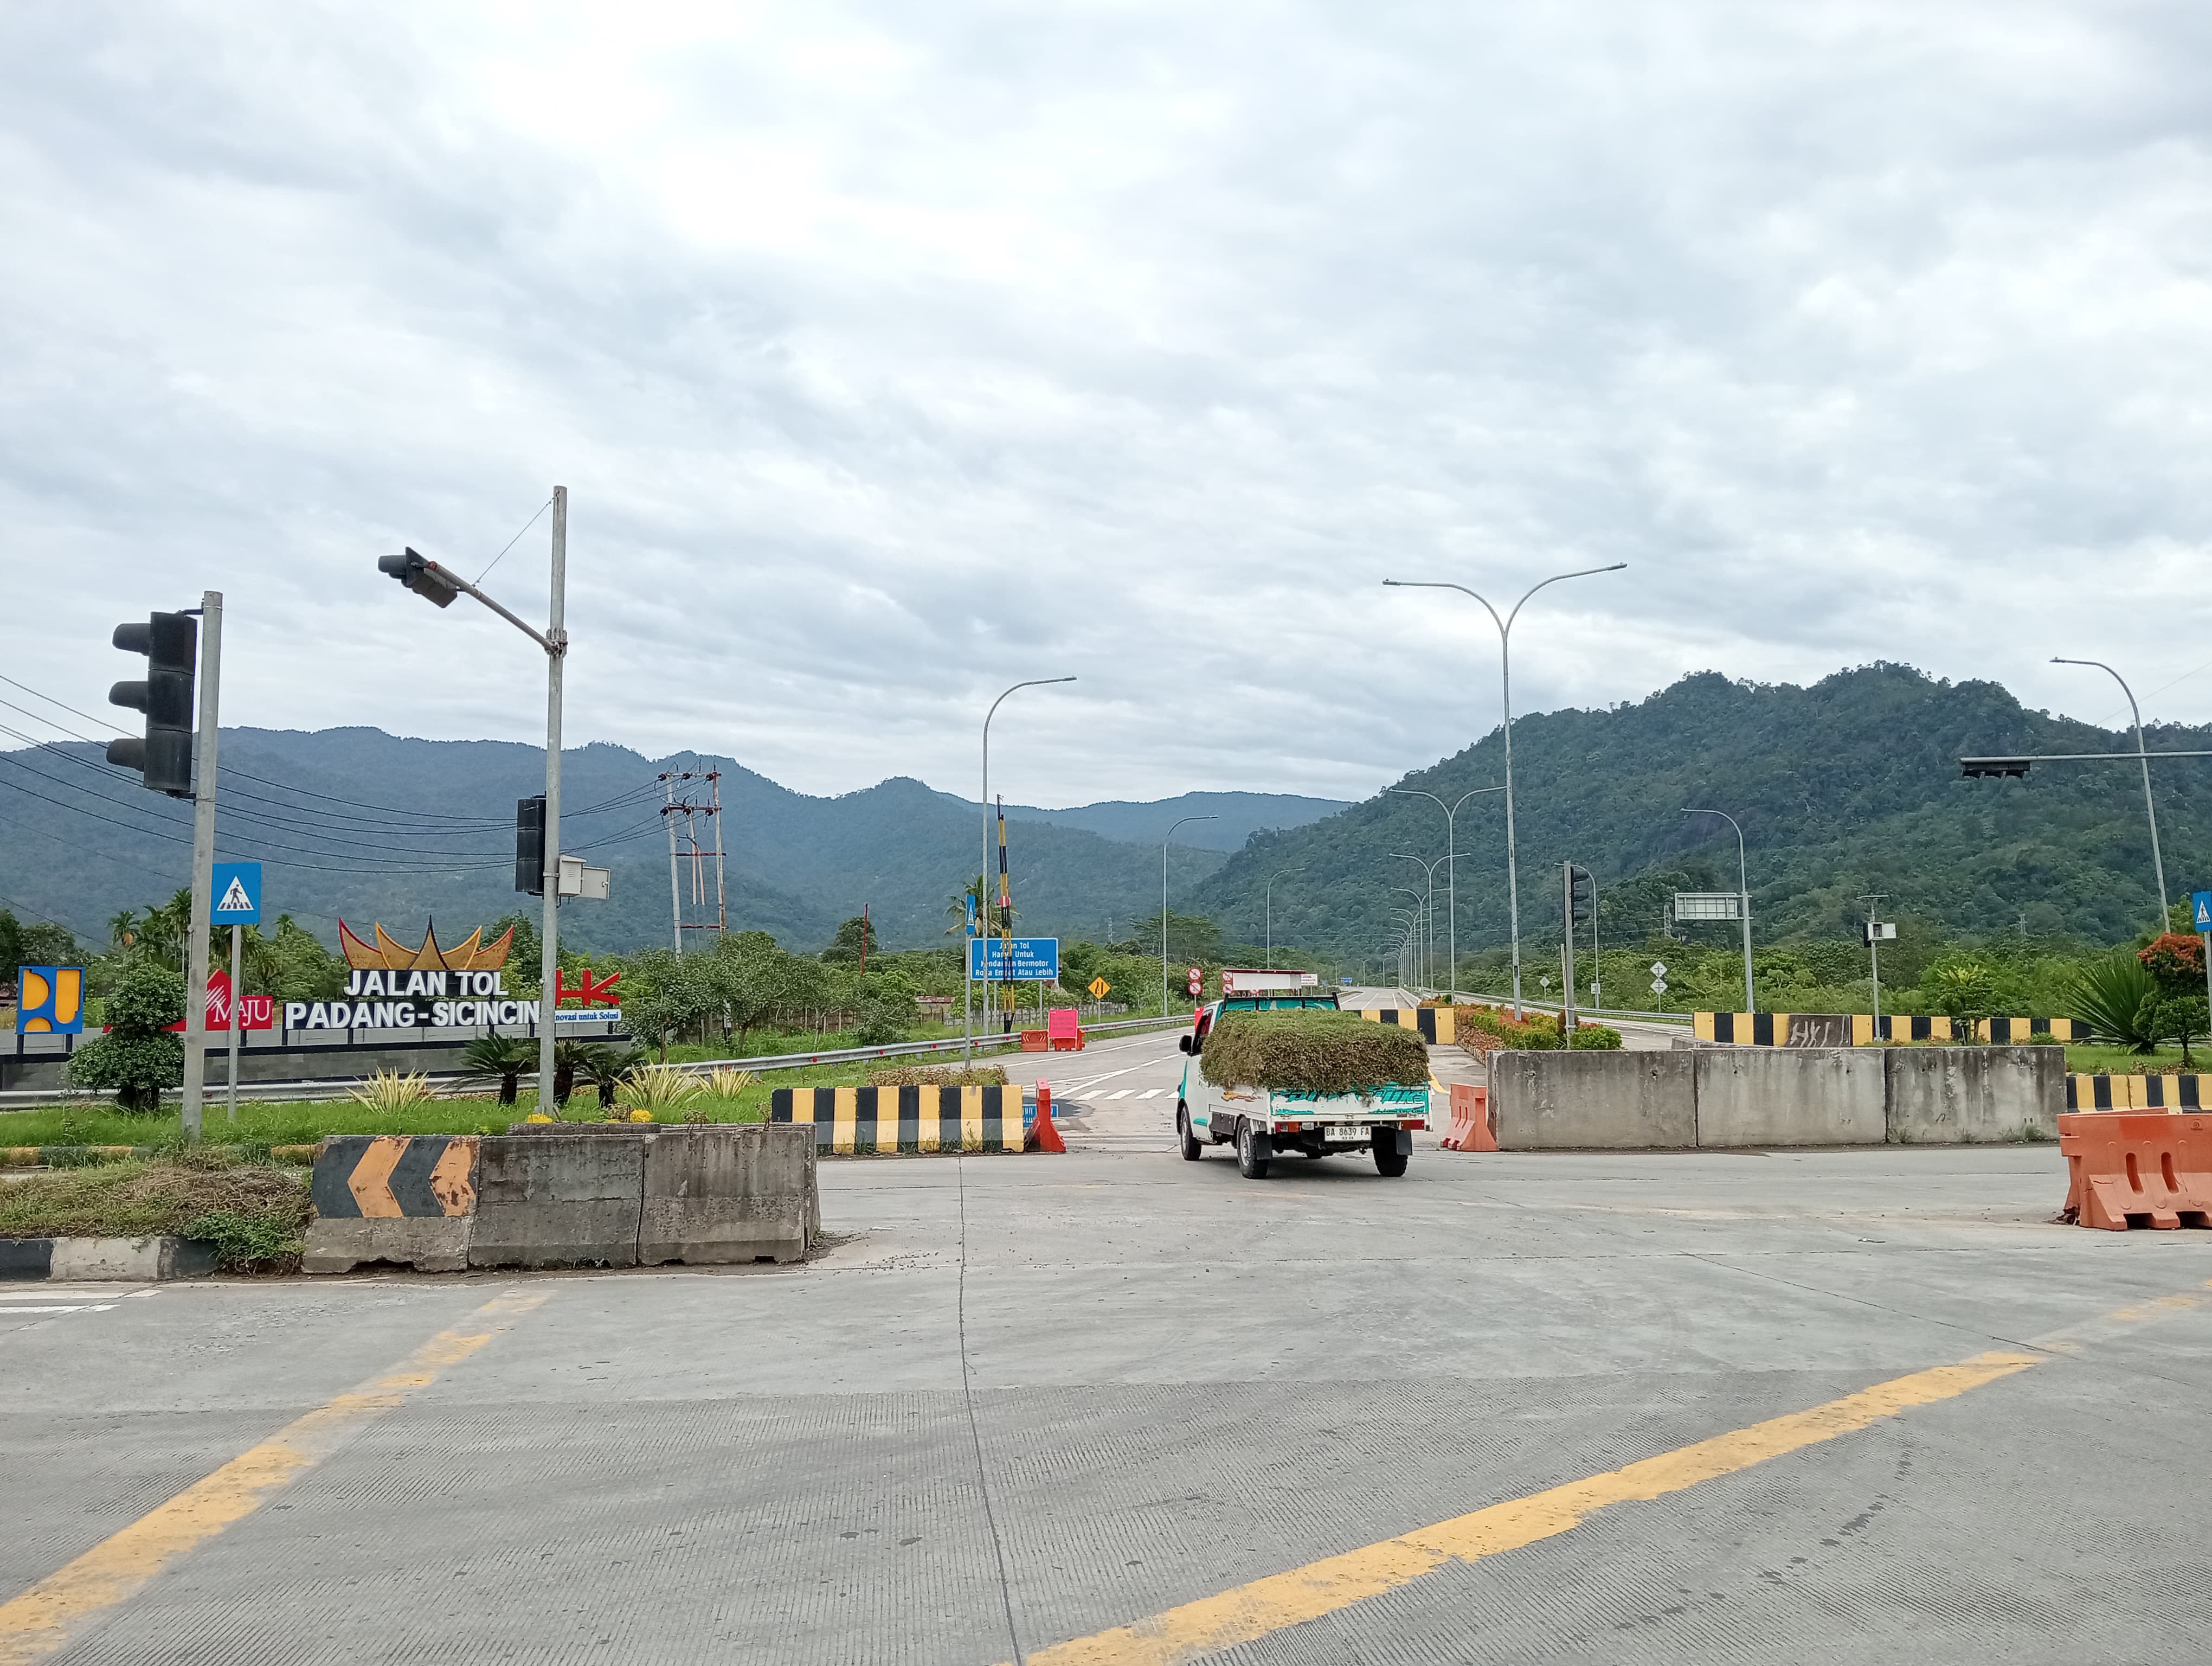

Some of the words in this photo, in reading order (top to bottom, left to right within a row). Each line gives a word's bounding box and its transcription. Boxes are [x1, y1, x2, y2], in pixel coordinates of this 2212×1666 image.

[343, 971, 447, 996] JALAN
[454, 971, 509, 996] TOL
[555, 969, 620, 1005] HK
[285, 1001, 540, 1029] PADANG-SICINCIN
[578, 1012, 597, 1020] untuk
[1326, 1127, 1335, 1136] BA
[1339, 1127, 1357, 1136] 8639
[1360, 1127, 1369, 1136] FA
